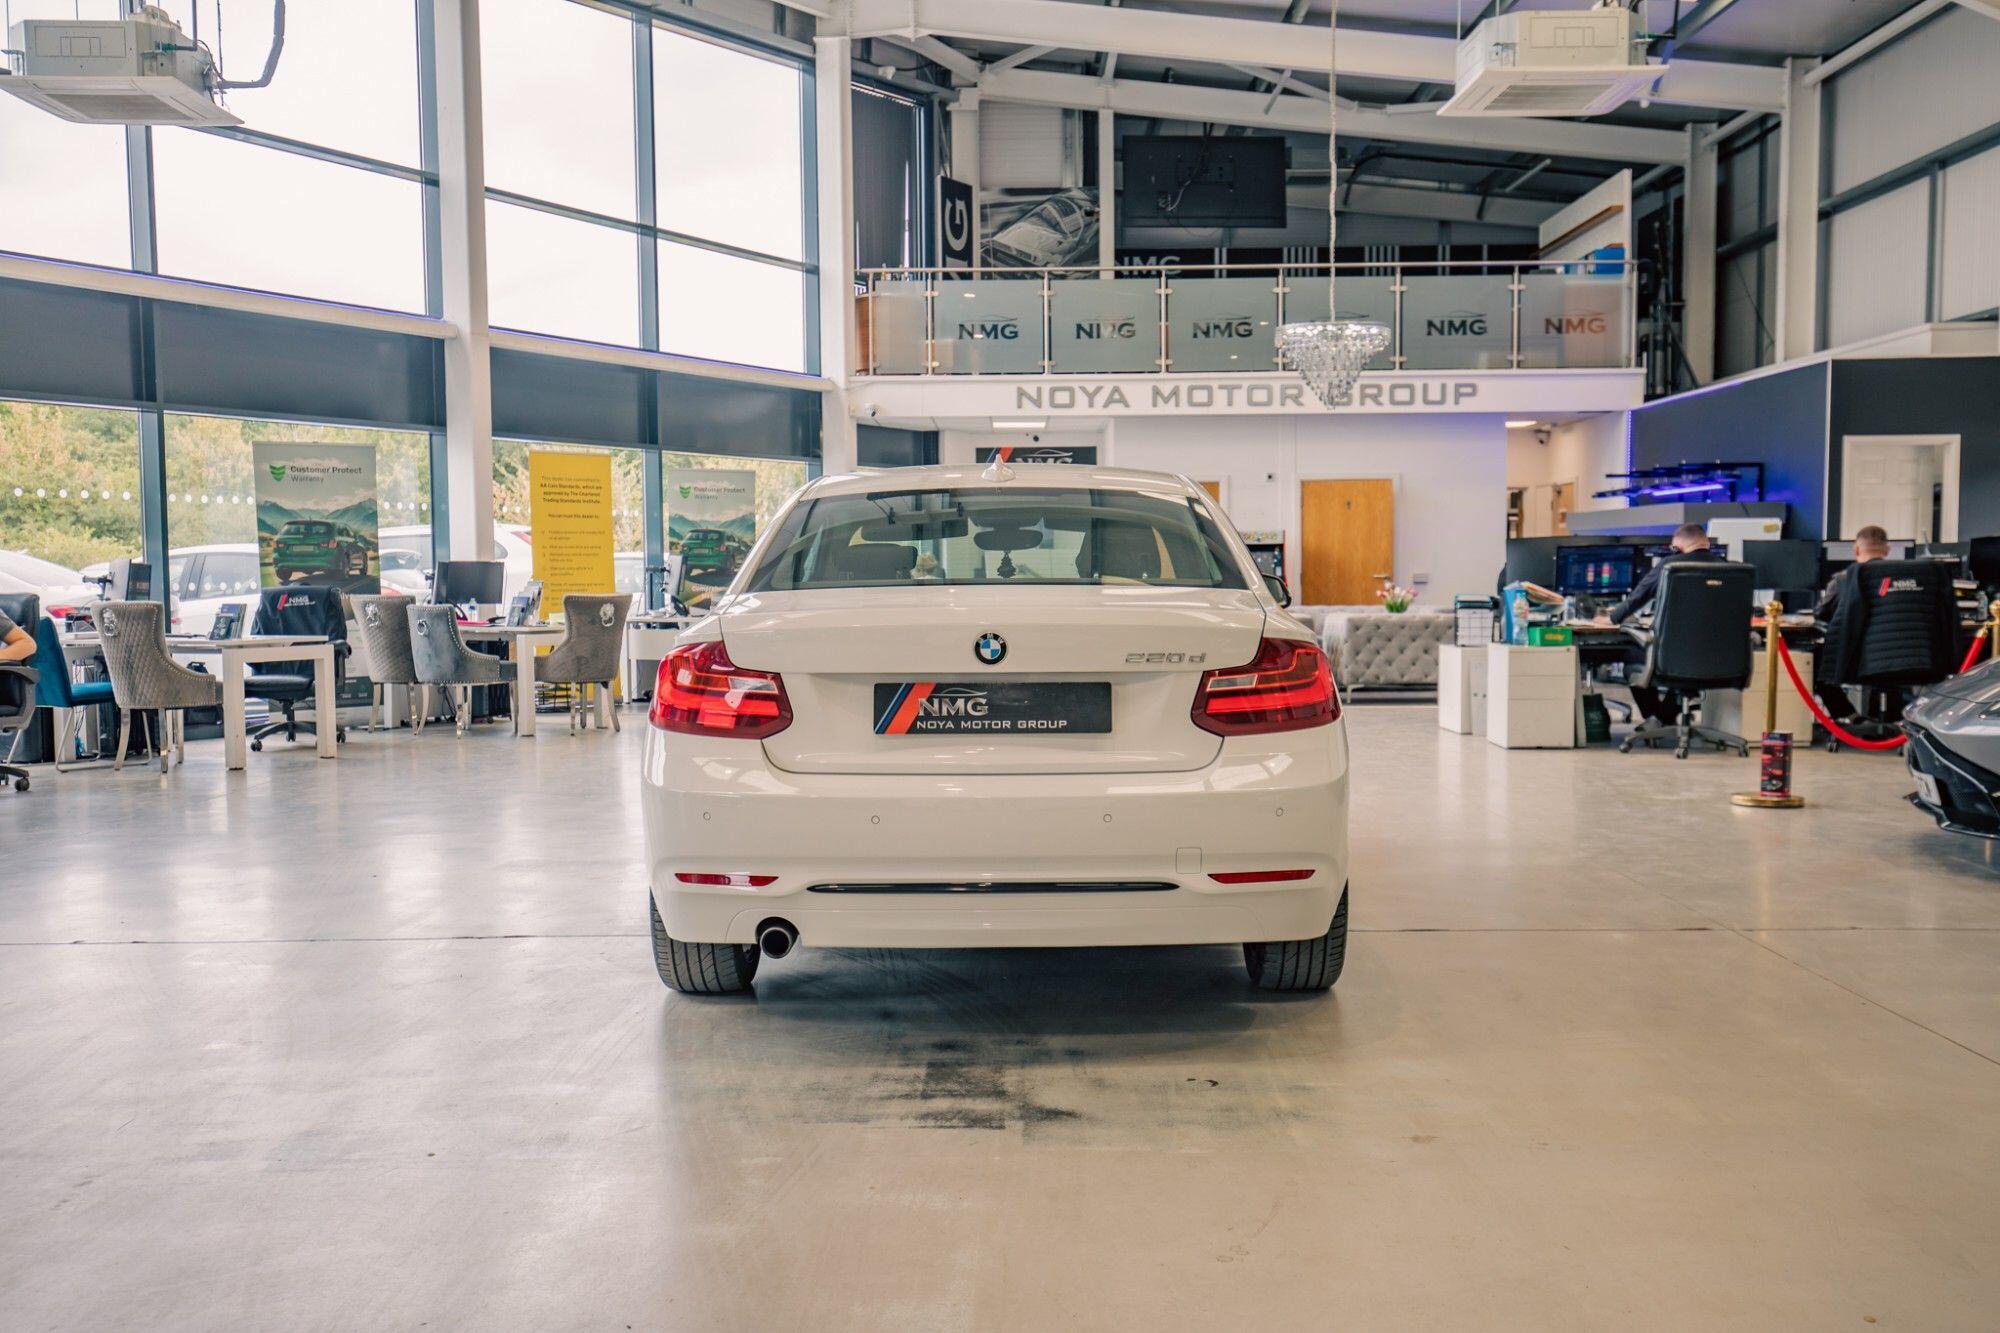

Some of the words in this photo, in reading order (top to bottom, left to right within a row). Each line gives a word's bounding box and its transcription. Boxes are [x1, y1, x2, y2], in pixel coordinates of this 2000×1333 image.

[959, 323, 1019, 340] NMG
[1076, 322, 1136, 340] NMG
[1192, 321, 1254, 339] NMG
[1426, 318, 1488, 337] NMG
[1545, 317, 1607, 335] NMG
[1016, 385, 1130, 409] NOYA
[1152, 384, 1304, 408] MOTOR
[290, 465, 330, 474] Customer
[332, 466, 362, 474] Protect
[917, 697, 989, 717] NMG
[916, 720, 955, 730] NOYA
[961, 720, 1011, 729] MOTOR
[1017, 720, 1067, 729] GROUP
